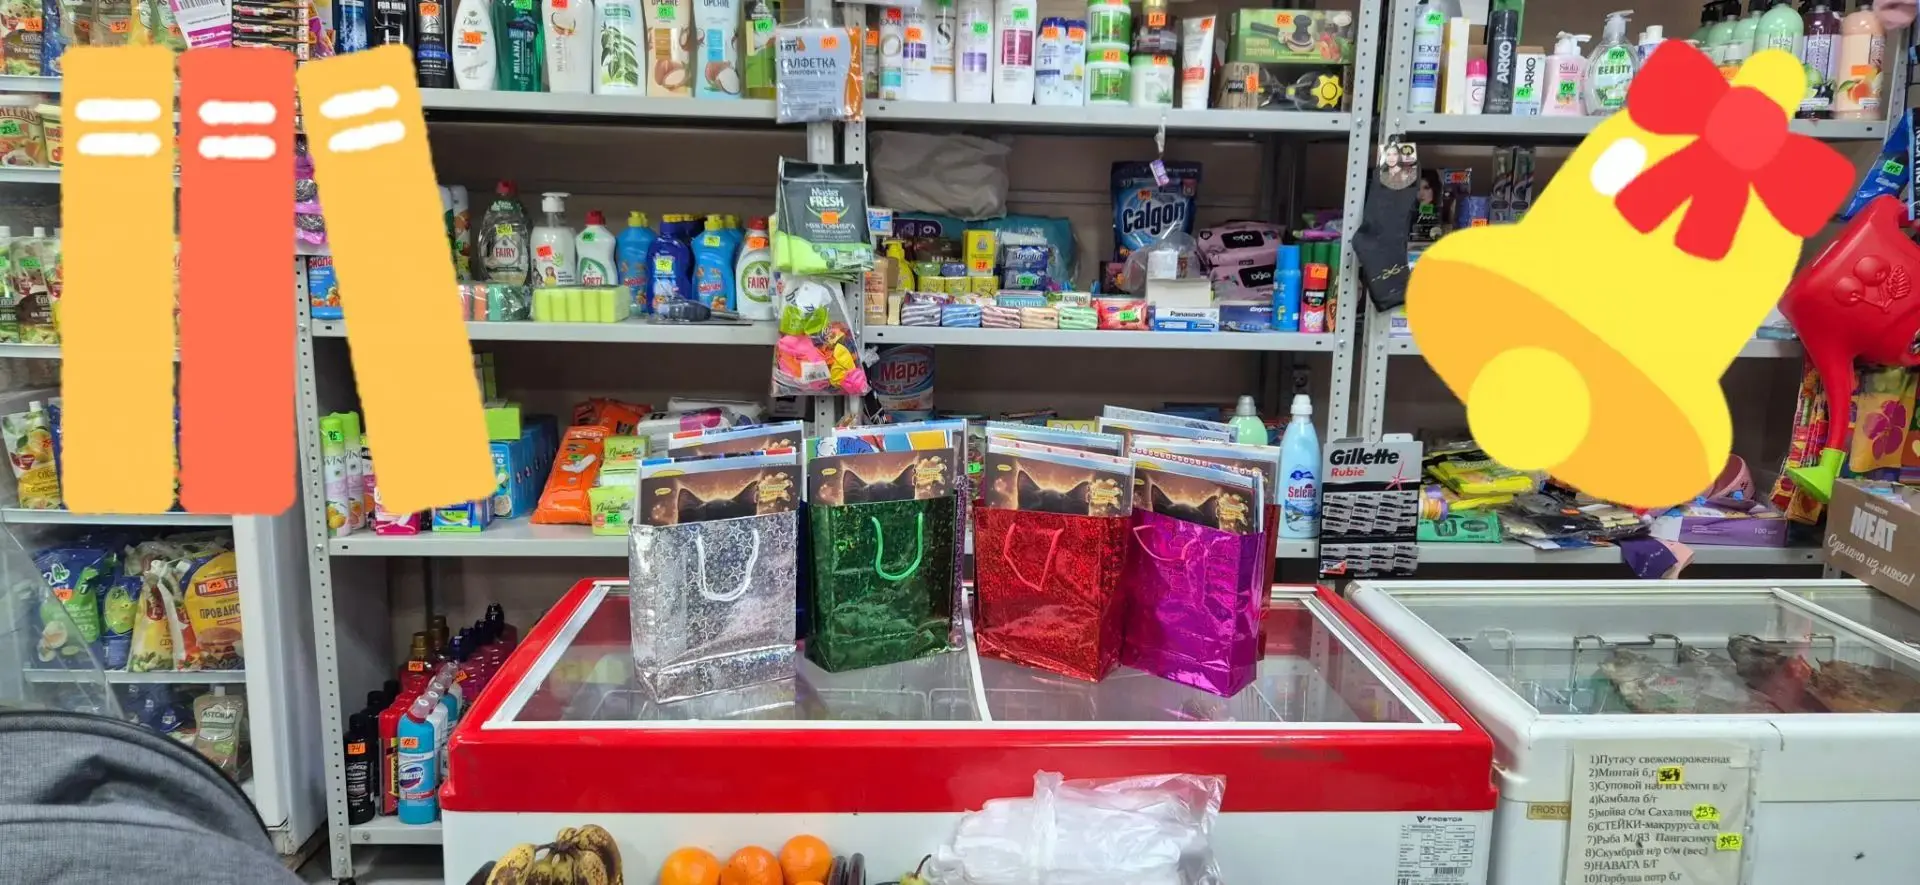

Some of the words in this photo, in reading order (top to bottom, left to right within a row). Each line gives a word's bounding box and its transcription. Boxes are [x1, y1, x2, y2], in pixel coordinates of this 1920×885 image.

[377, 1, 390, 9] FOR
[512, 40, 521, 74] MILANA
[1497, 41, 1512, 84] ARKO
[781, 58, 836, 69] САЛФЕТКА
[1524, 57, 1536, 90] ARKO
[1598, 64, 1631, 75] BEAUTY
[809, 196, 845, 207] FRESH
[1122, 201, 1186, 235] Calgon
[495, 247, 516, 258] FAIRY
[747, 276, 769, 289] FAIRY
[1170, 310, 1206, 318] Panasonic
[1329, 447, 1399, 466] Gillette
[1331, 467, 1364, 477] Rubie
[1288, 485, 1317, 498] Selena
[1850, 506, 1898, 552] MEAT
[203, 710, 234, 720] ASTORIA
[1590, 755, 1635, 766] 1)Путасу
[1588, 768, 1640, 777] 2)Минтай
[1589, 781, 1642, 791] 3)Суповой
[1589, 794, 1640, 804] 4)Камбала
[1588, 807, 1626, 819] 5)мойва
[1628, 807, 1645, 816] с/м
[1586, 833, 1621, 845] 7)Рыба
[1664, 846, 1680, 855] с/м
[1683, 846, 1708, 856] (вес)
[1584, 861, 1640, 872] 9)НАВАГА
[1584, 873, 1642, 884] 10)Горбуша
